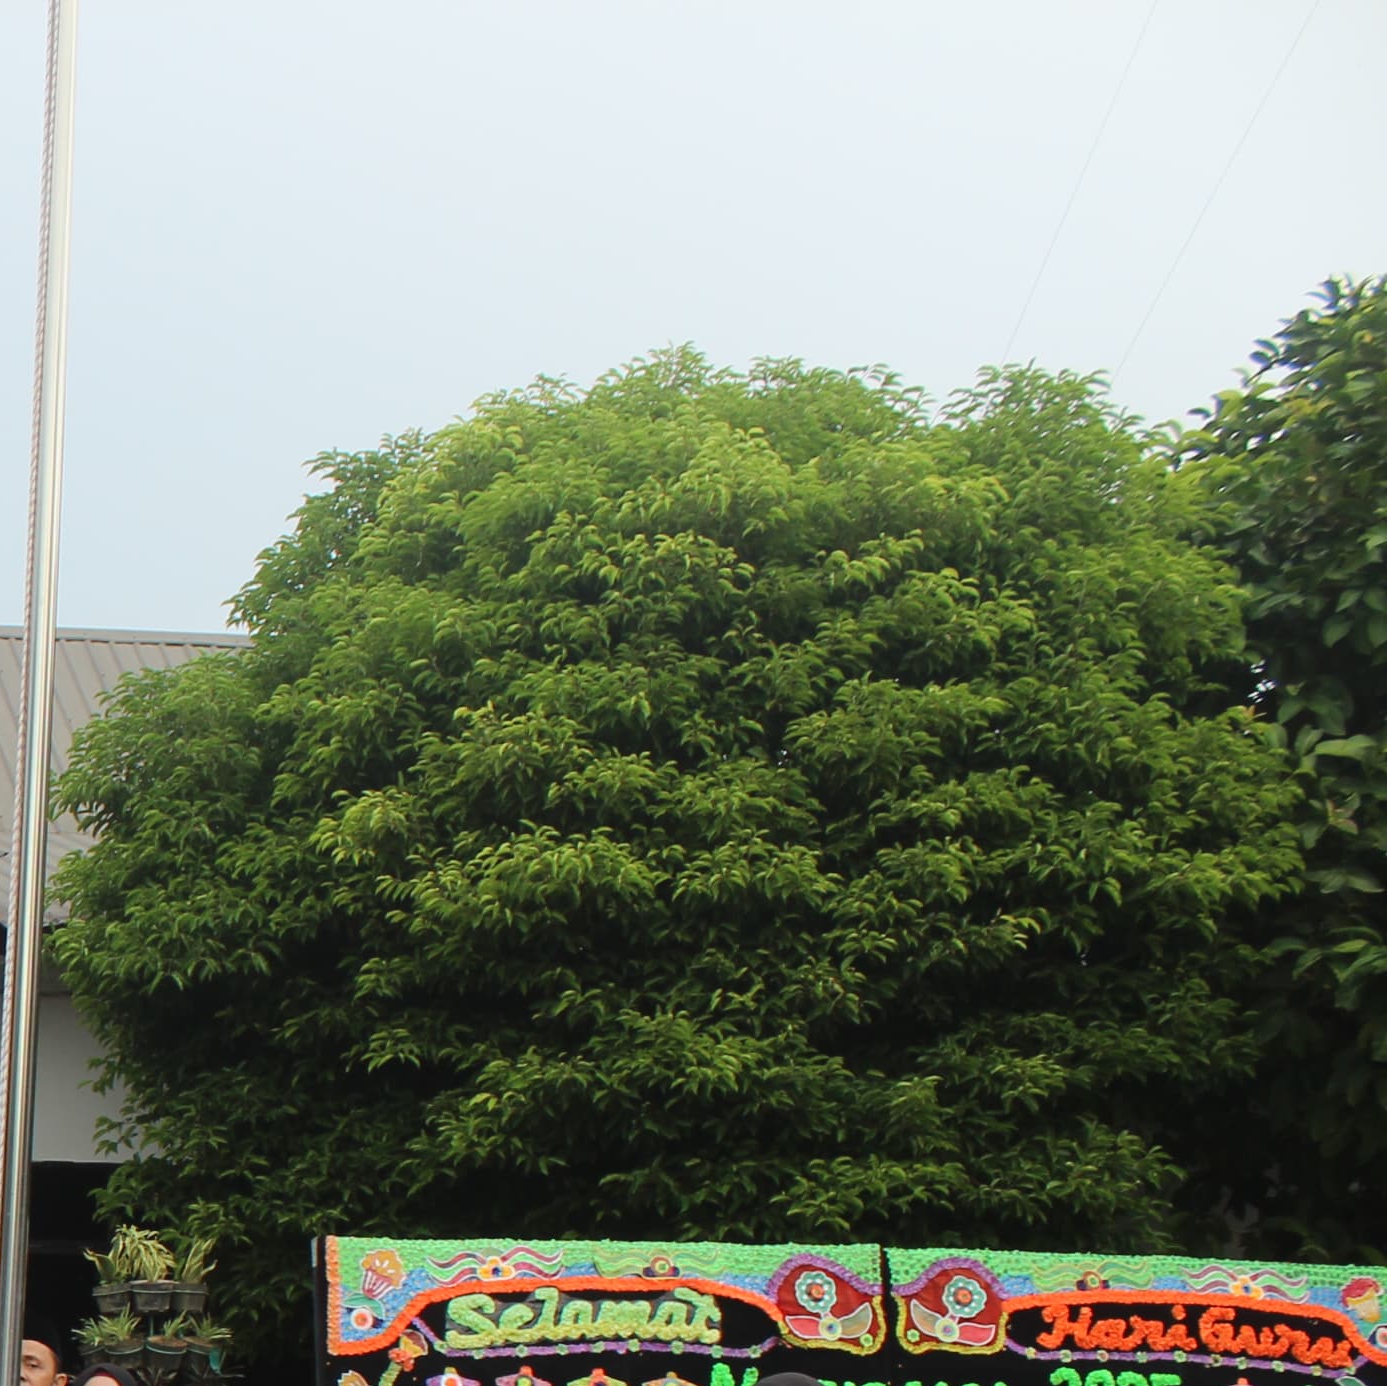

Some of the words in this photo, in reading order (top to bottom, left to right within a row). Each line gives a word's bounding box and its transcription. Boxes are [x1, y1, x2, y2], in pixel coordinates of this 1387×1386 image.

[444, 1286, 722, 1348] Selamat
[1035, 1303, 1198, 1352] Hari
[1198, 1306, 1354, 1368] Guru
